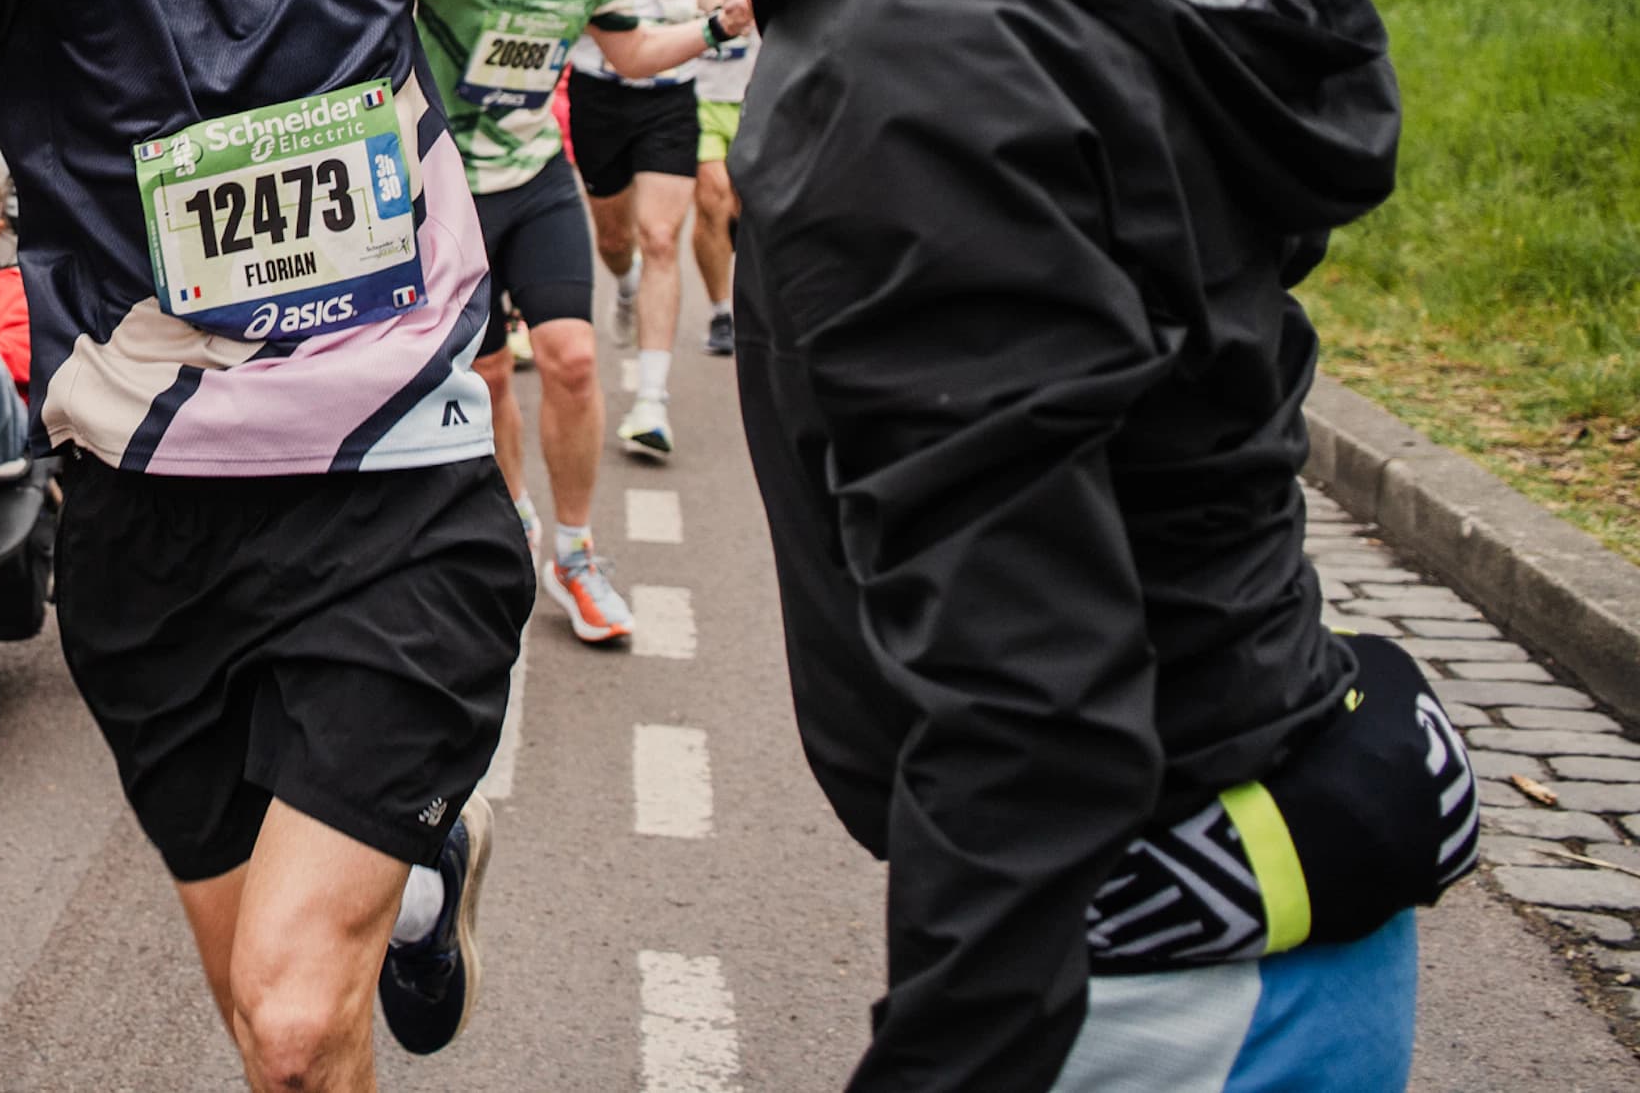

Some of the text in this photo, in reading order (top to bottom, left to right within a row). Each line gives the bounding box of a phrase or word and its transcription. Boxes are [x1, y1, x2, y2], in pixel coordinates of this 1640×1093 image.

[206, 95, 361, 151] Schneider
[280, 122, 365, 153] Electric
[378, 175, 402, 202] 30
[186, 158, 356, 259] 12473
[244, 251, 317, 287] FLORIAN
